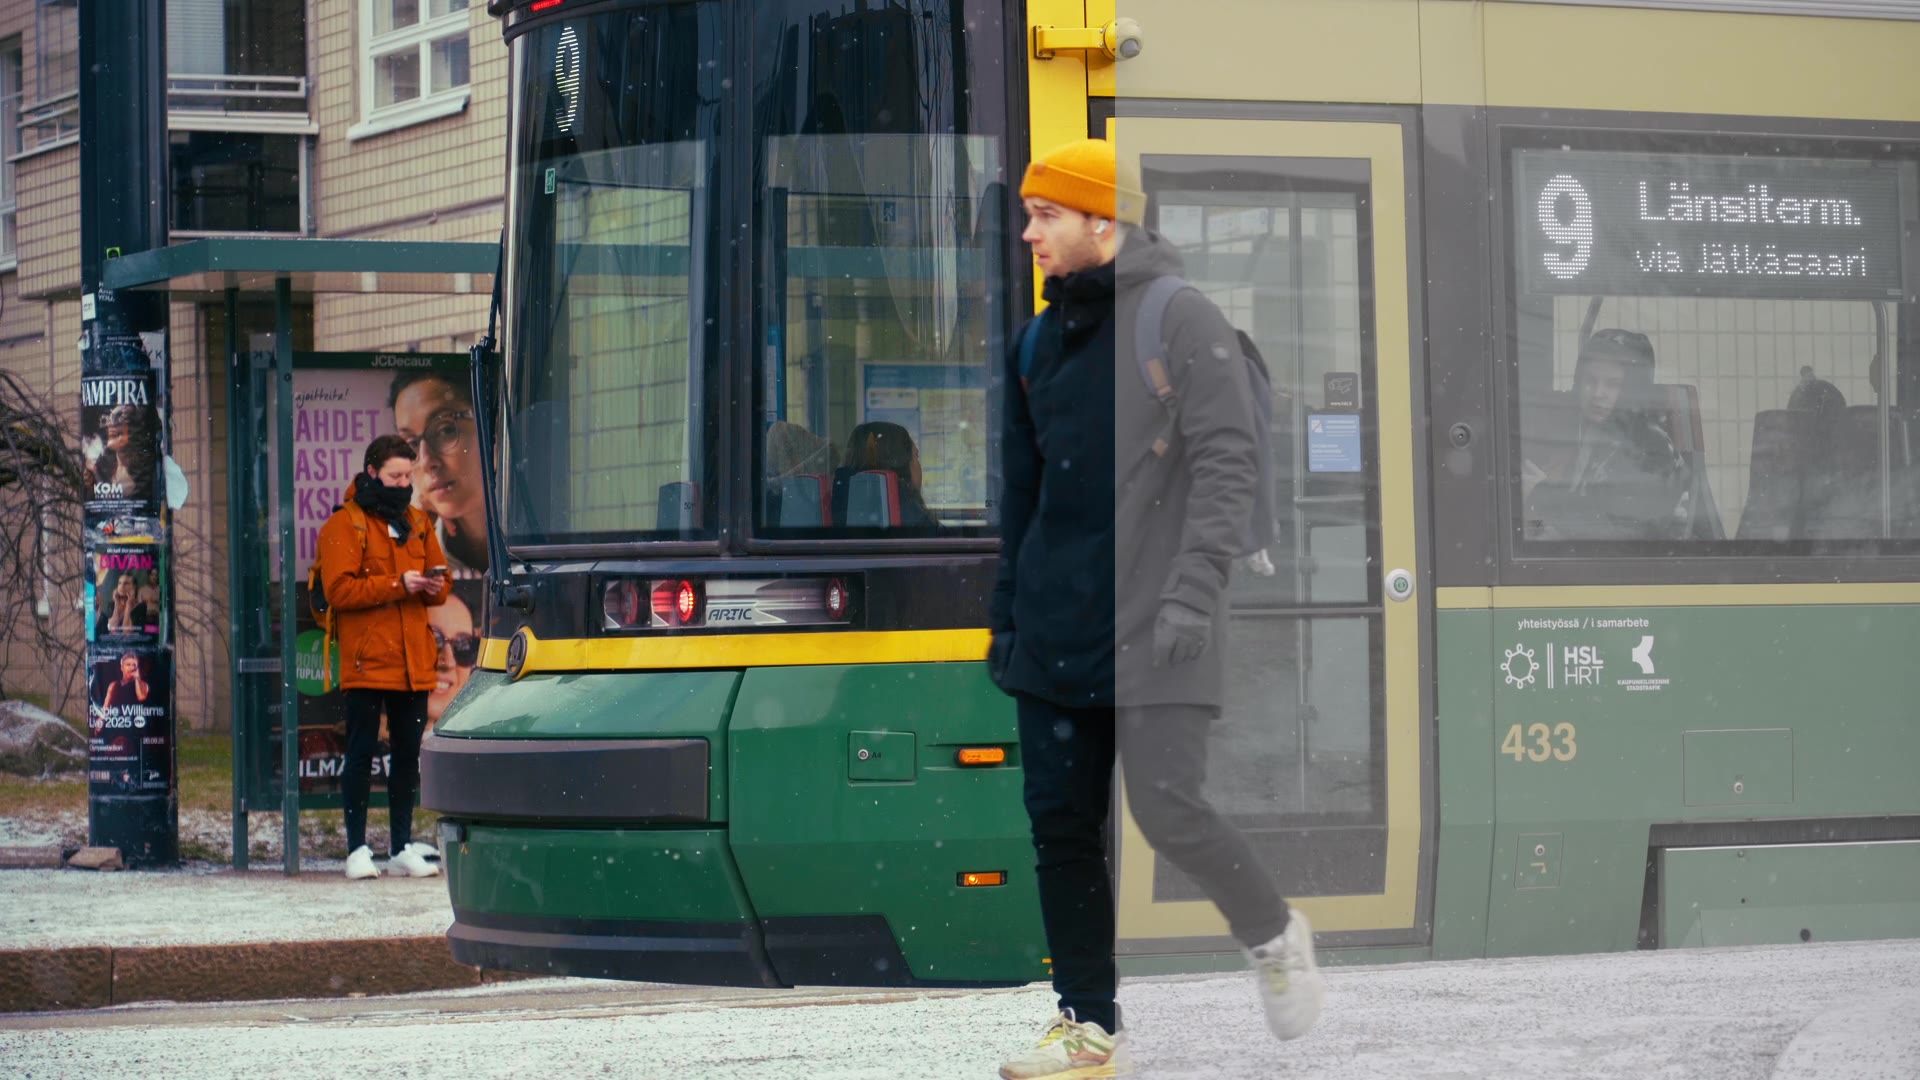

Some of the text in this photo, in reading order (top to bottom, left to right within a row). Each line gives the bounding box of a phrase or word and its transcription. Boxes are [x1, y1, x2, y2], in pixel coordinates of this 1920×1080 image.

[555, 26, 580, 132] 9
[1639, 181, 1861, 225] Länsiterm.
[1538, 174, 1593, 279] 9
[1636, 242, 1866, 276] via Jätkäsaari
[371, 356, 432, 367] JCDecaux
[82, 380, 148, 407] VAMPIRA
[295, 409, 380, 442] AHDET
[295, 448, 352, 481] ASIT
[94, 482, 123, 494] KOM
[100, 554, 153, 570] DIVAN
[708, 608, 752, 621] ARTIC
[1517, 618, 1579, 630] yhteistyössä
[1591, 618, 1595, 628] i
[1597, 617, 1649, 628] samarbete
[1564, 646, 1604, 665] HSL
[1564, 665, 1604, 685] HRT
[121, 704, 164, 717] Williams
[105, 717, 131, 728] 2025
[1501, 722, 1577, 762] 433
